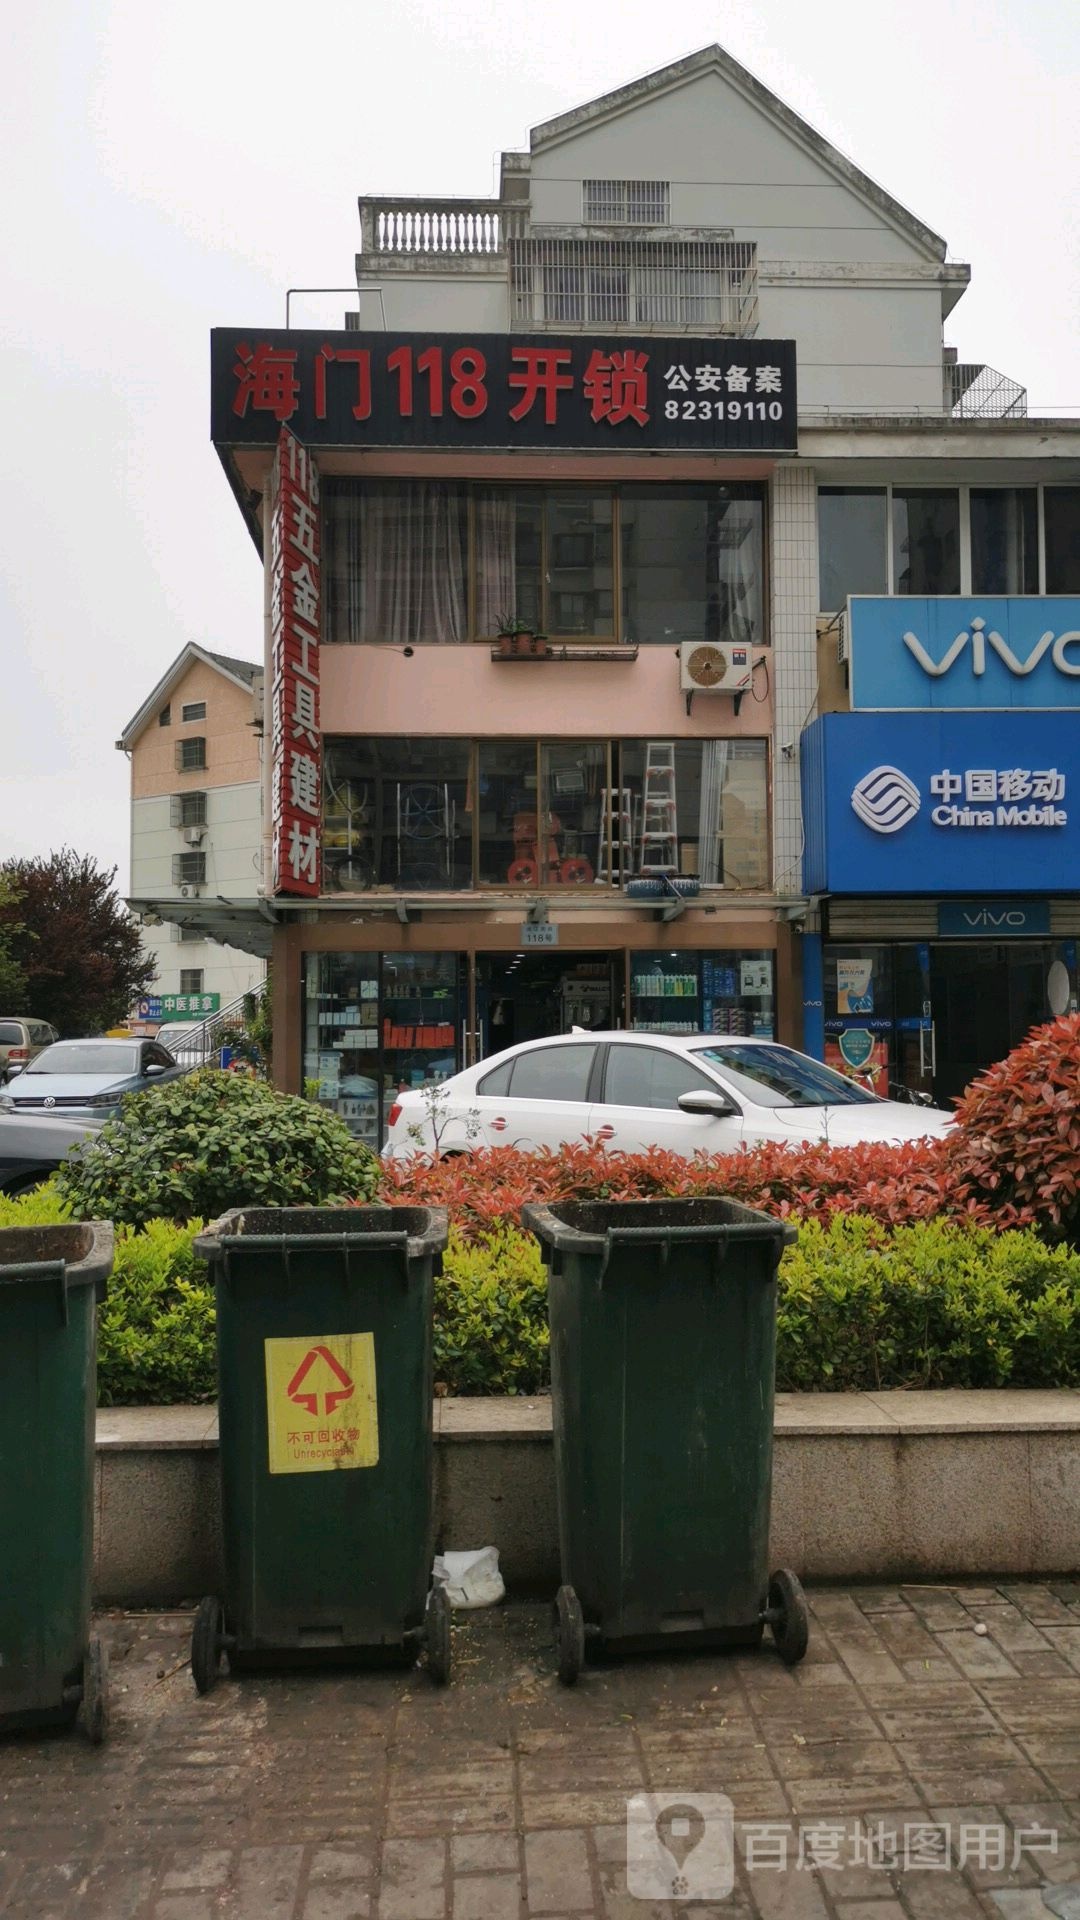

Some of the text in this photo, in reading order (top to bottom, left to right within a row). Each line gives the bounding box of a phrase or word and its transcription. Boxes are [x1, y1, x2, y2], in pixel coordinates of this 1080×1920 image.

[231, 341, 650, 428] 海门118开锁
[663, 364, 783, 393] 公安备案
[664, 400, 783, 421] 82319110
[930, 767, 1066, 803] 中国移动
[931, 804, 1068, 827] China Mobile
[963, 908, 1026, 926] vivo
[871, 1020, 892, 1028] vivo
[287, 1427, 361, 1445] 不可回收物
